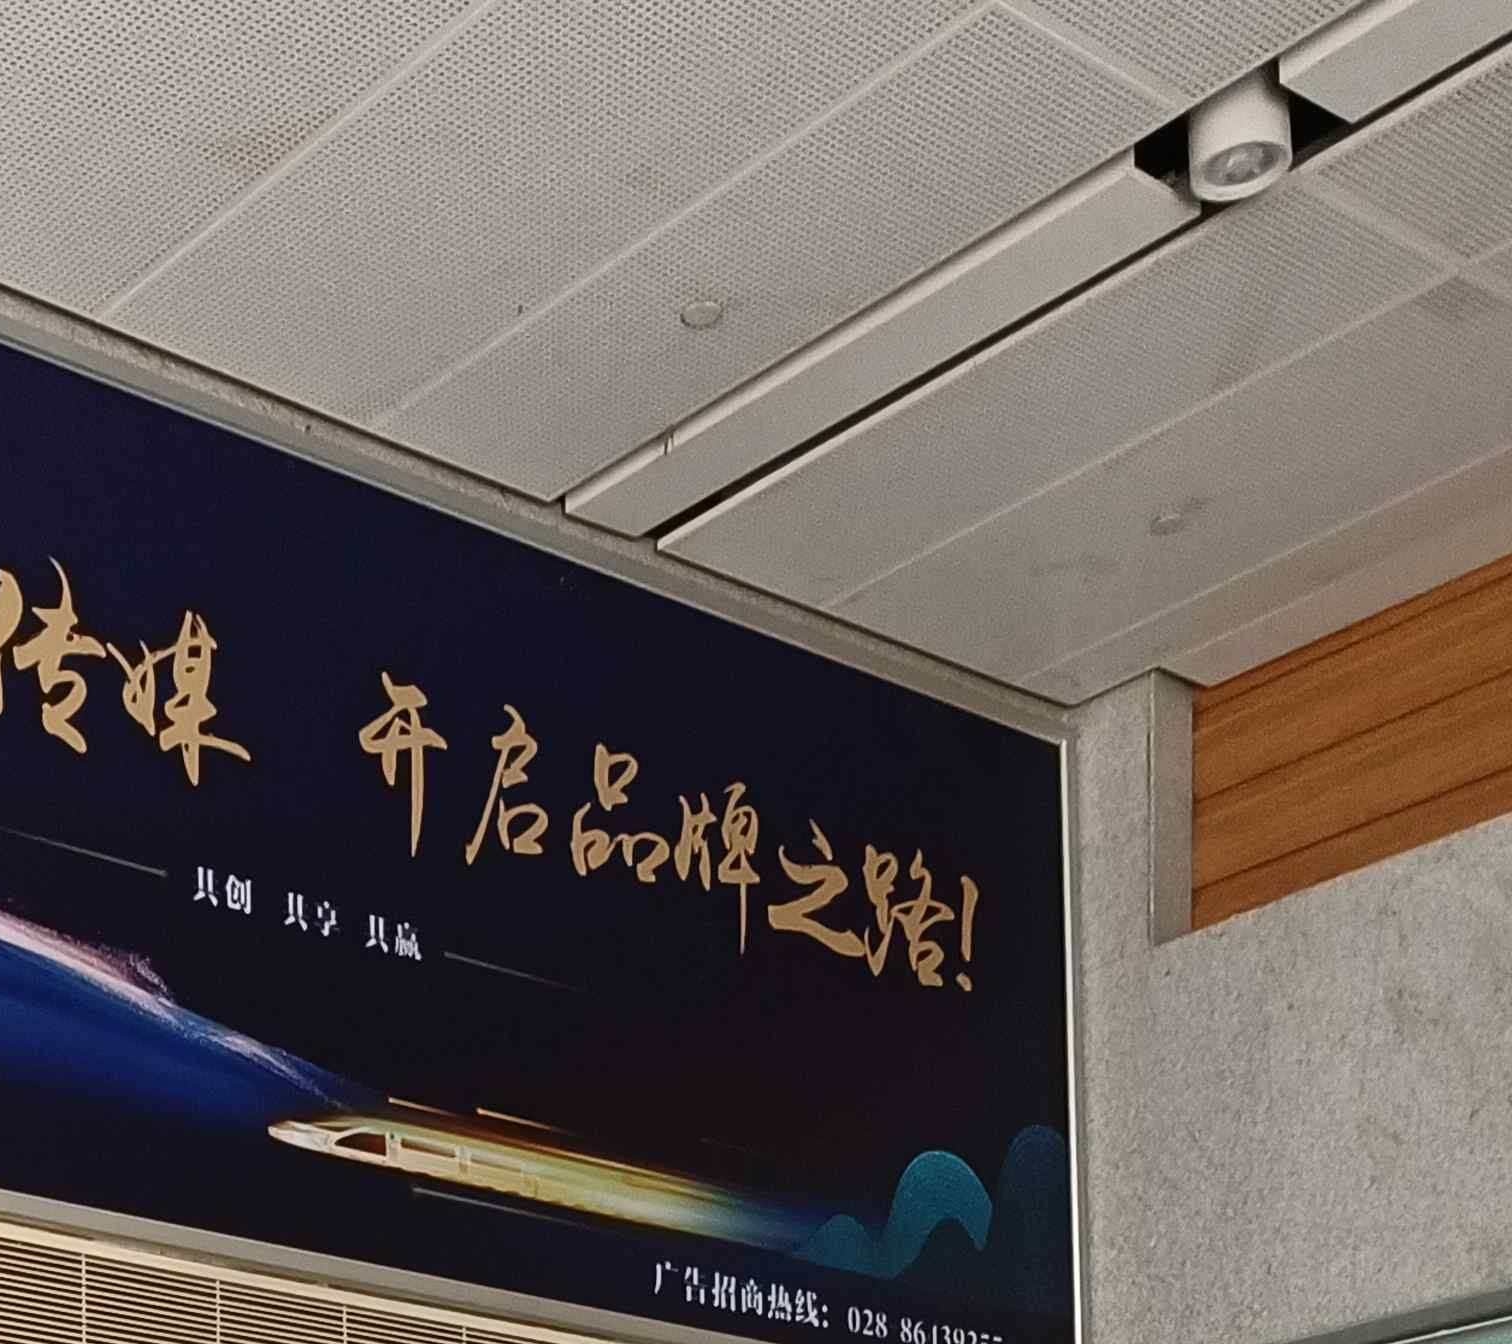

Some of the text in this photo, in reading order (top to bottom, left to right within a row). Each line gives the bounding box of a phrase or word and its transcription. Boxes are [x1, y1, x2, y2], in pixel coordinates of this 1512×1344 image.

[192, 865, 422, 961] 共创 共享 共赢
[847, 1306, 888, 1339] 028
